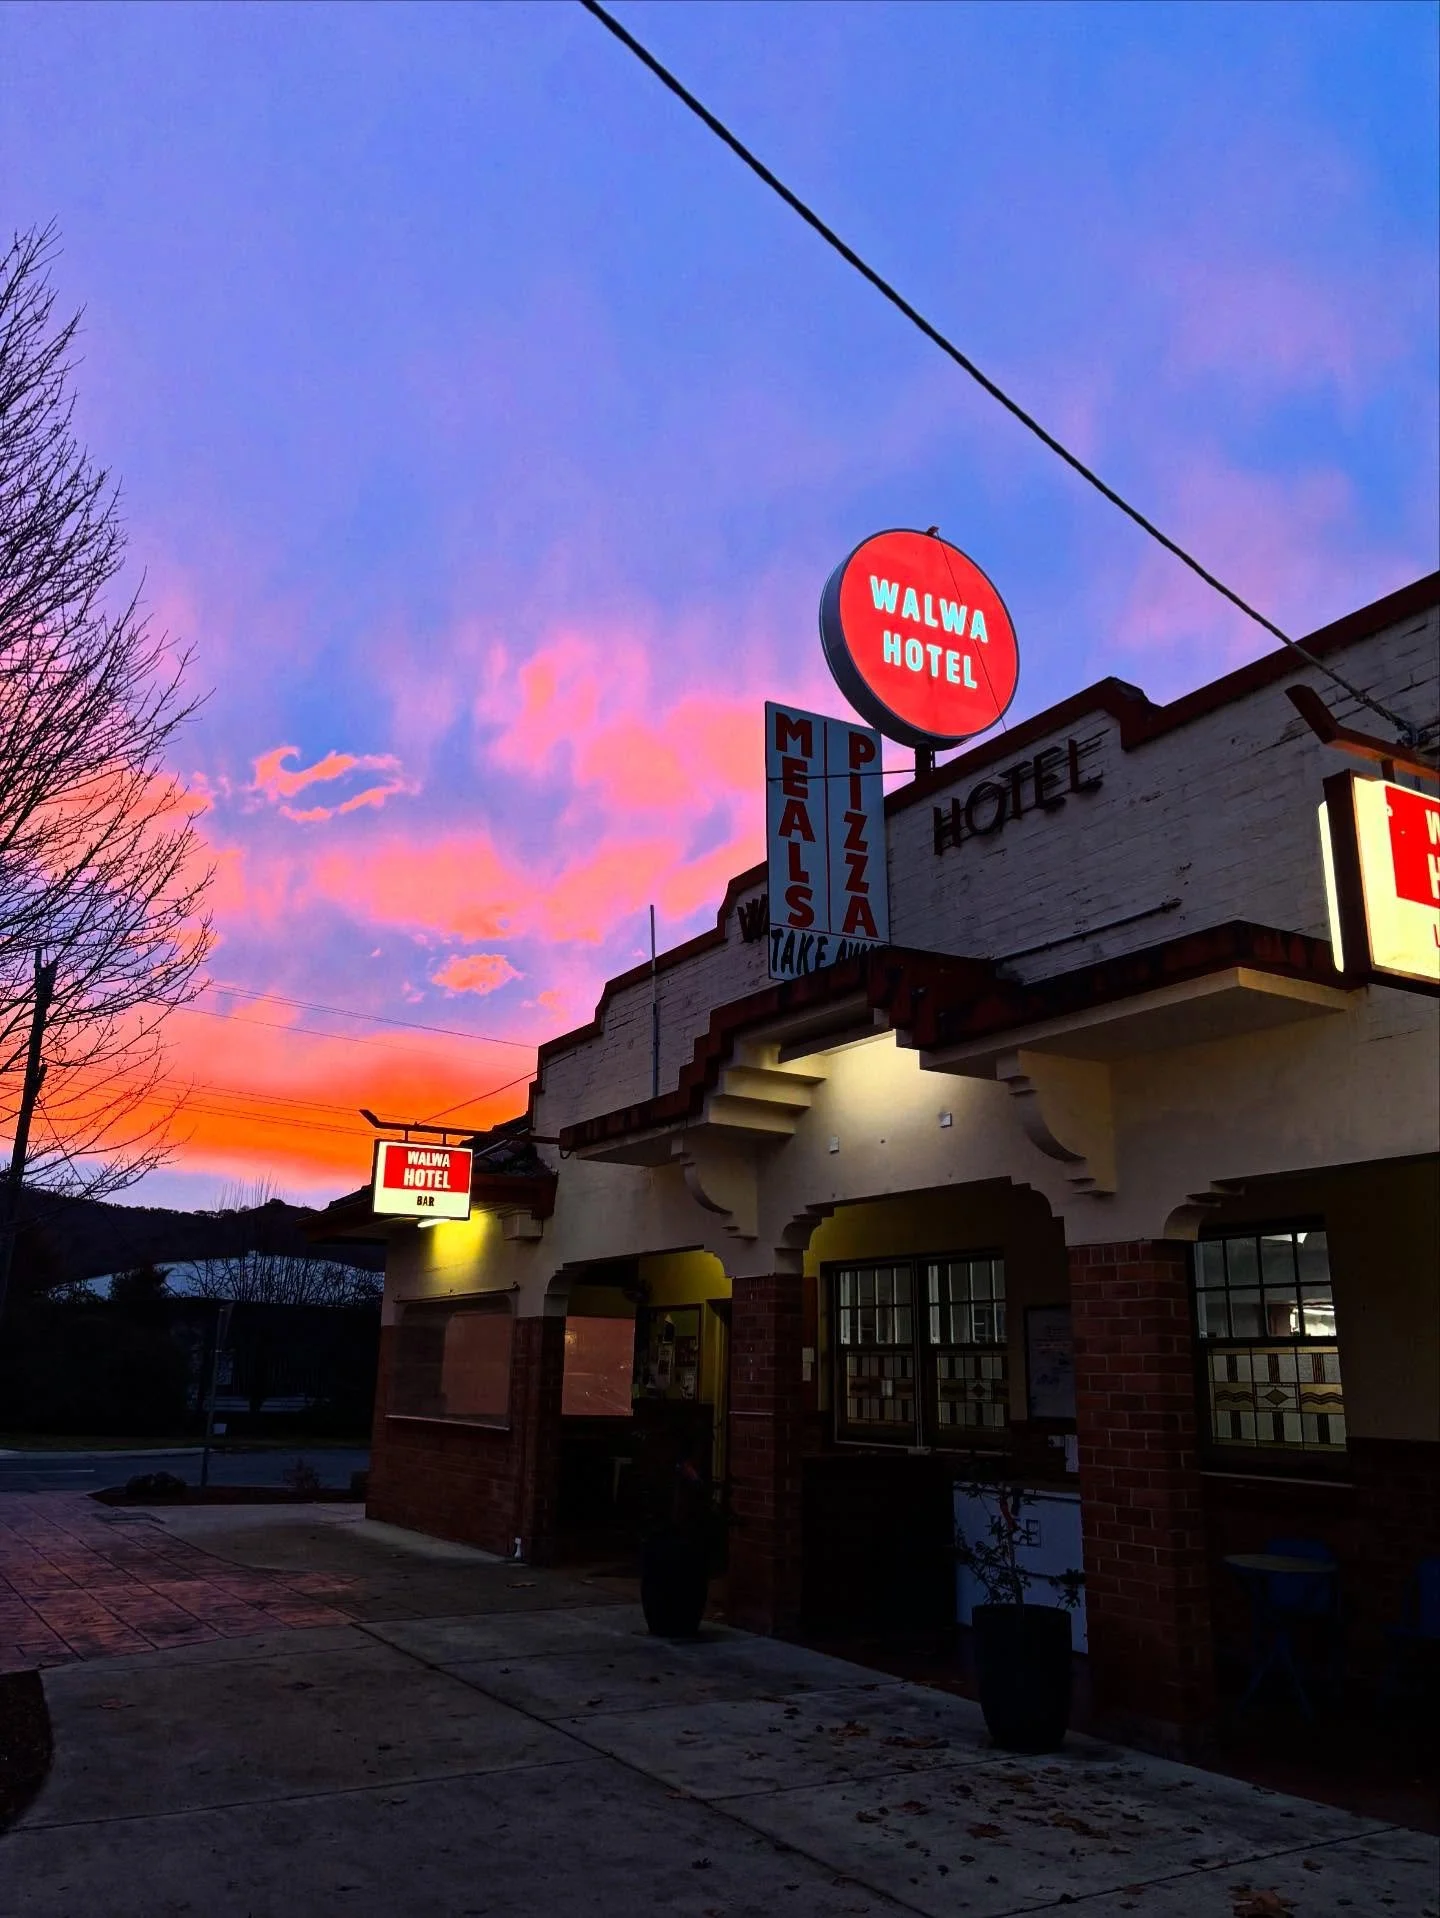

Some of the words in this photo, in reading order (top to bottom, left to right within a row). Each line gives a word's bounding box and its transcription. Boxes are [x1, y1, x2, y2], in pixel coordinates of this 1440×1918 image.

[870, 575, 989, 643] WALWA
[883, 630, 978, 689] HOTEL
[775, 712, 815, 929] MEALS
[933, 739, 1104, 856] HOTEL
[843, 731, 879, 938] PIZZA
[770, 928, 828, 975] TAKE
[403, 1168, 451, 1189] HOTEL
[407, 1150, 451, 1168] WALWA
[416, 1195, 435, 1207] BAR
